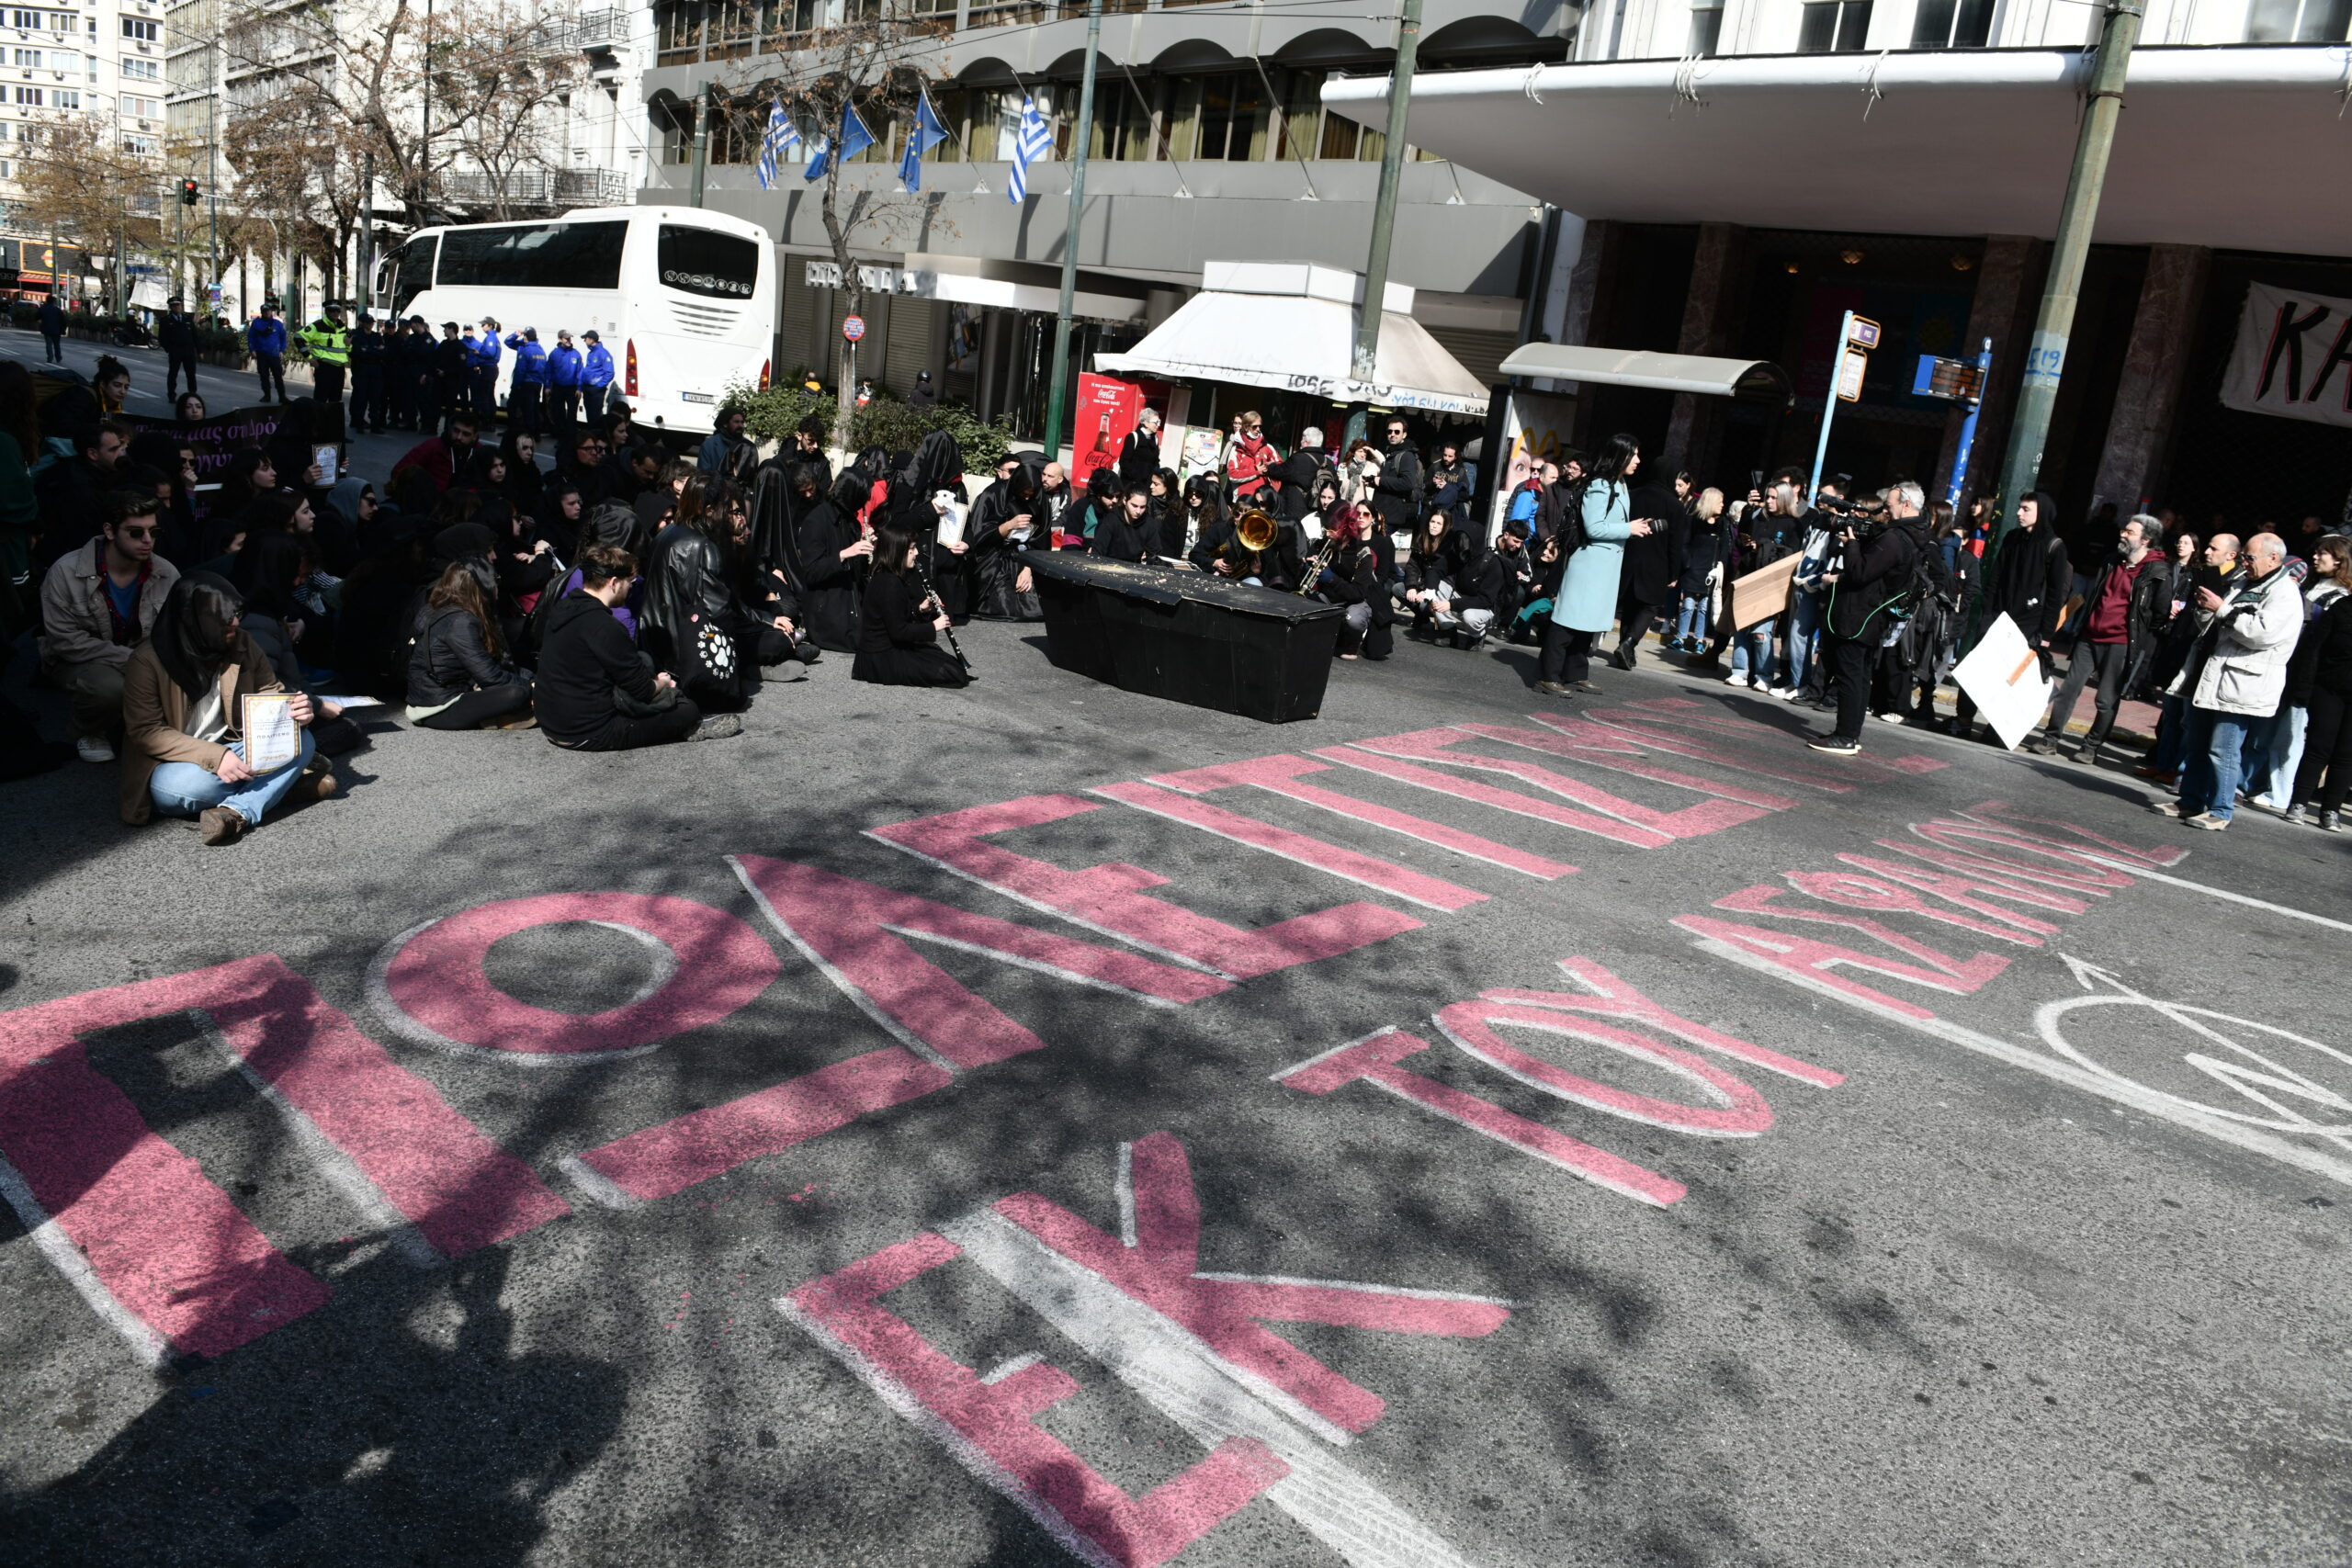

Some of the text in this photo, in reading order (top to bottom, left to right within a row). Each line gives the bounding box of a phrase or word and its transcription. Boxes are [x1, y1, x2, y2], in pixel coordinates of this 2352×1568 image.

[776, 801, 2190, 1568] ΕΚ ΤΟΥ ΑΣΦΑΛΟΥΣ
